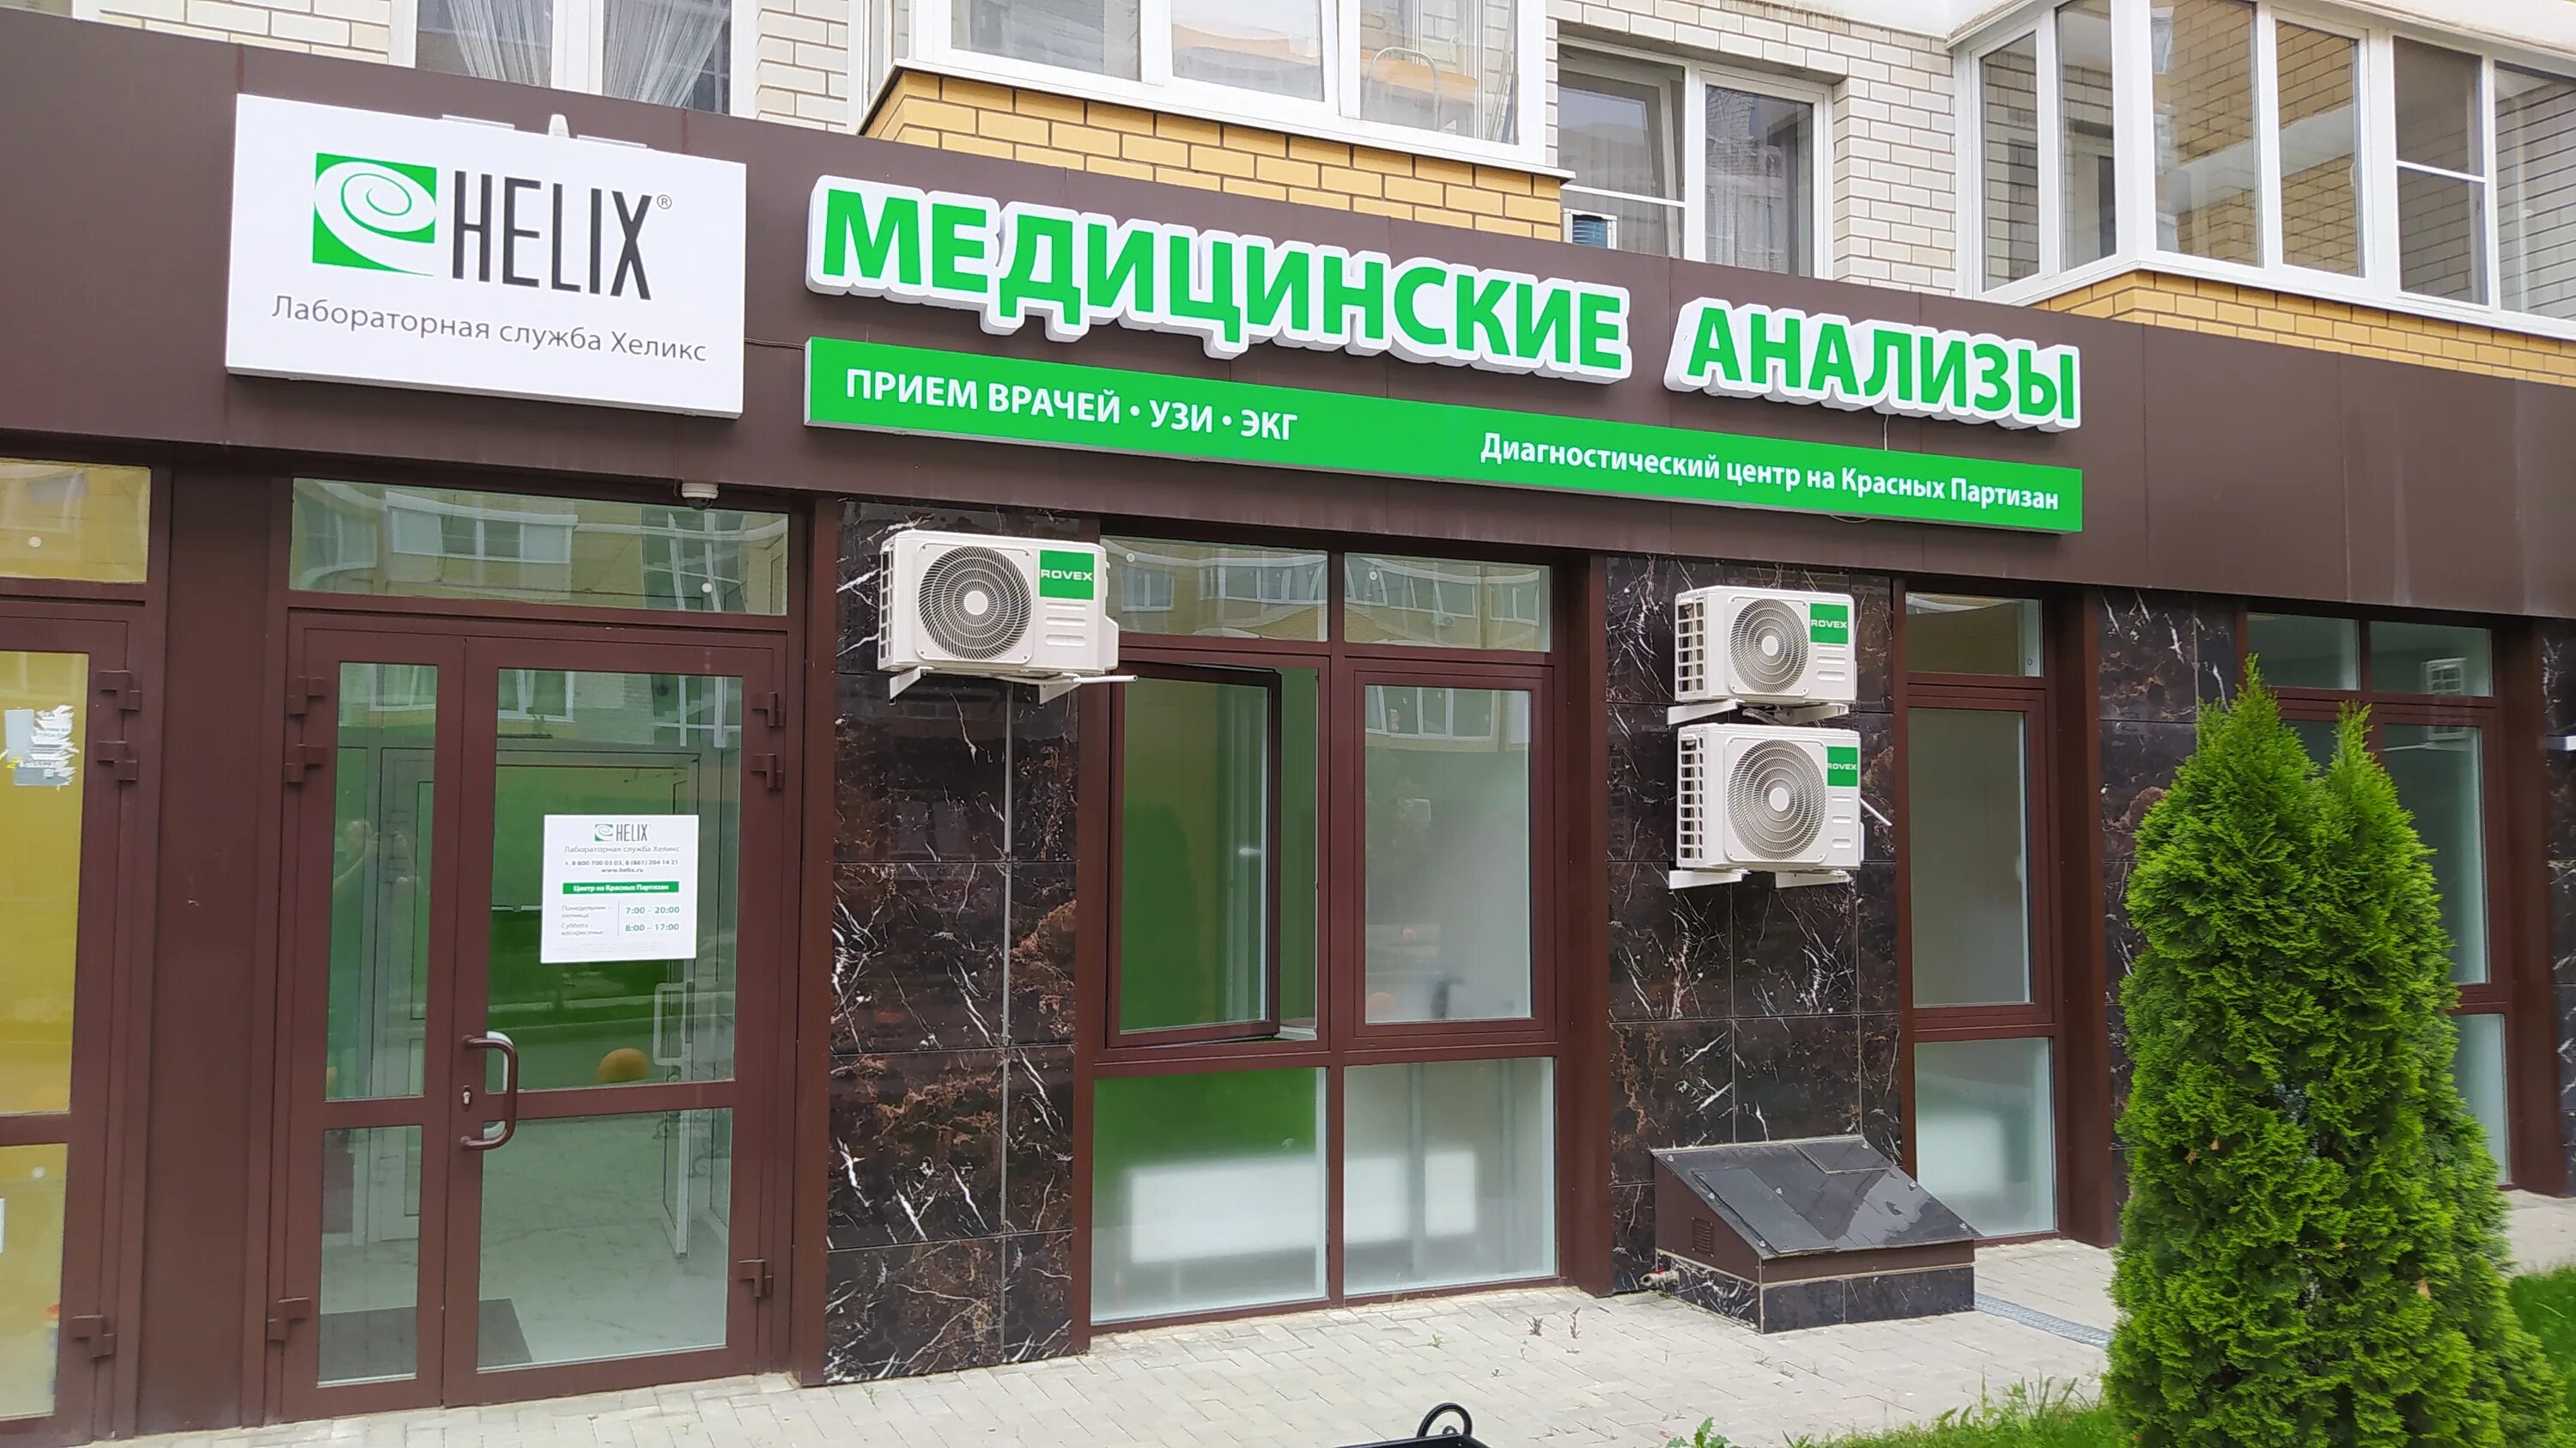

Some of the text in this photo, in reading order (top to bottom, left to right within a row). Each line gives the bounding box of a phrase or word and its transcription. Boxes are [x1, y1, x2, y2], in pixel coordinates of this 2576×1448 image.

[271, 295, 707, 362] Лабораторная служба Хеликс
[823, 188, 2075, 420] МЕДИЦИНСКИЕ АНАЛИЗЫ
[847, 368, 978, 409] ПРИЕМ
[989, 383, 1121, 424] ВРАЧЕЙ
[1149, 399, 1212, 433] УЗИ
[1240, 409, 1297, 441] ЭКГ
[1480, 432, 2058, 511] Диагностический центр на Красных Партизан
[1040, 569, 1093, 581] ROVEX
[1810, 619, 1848, 629] ROVEX
